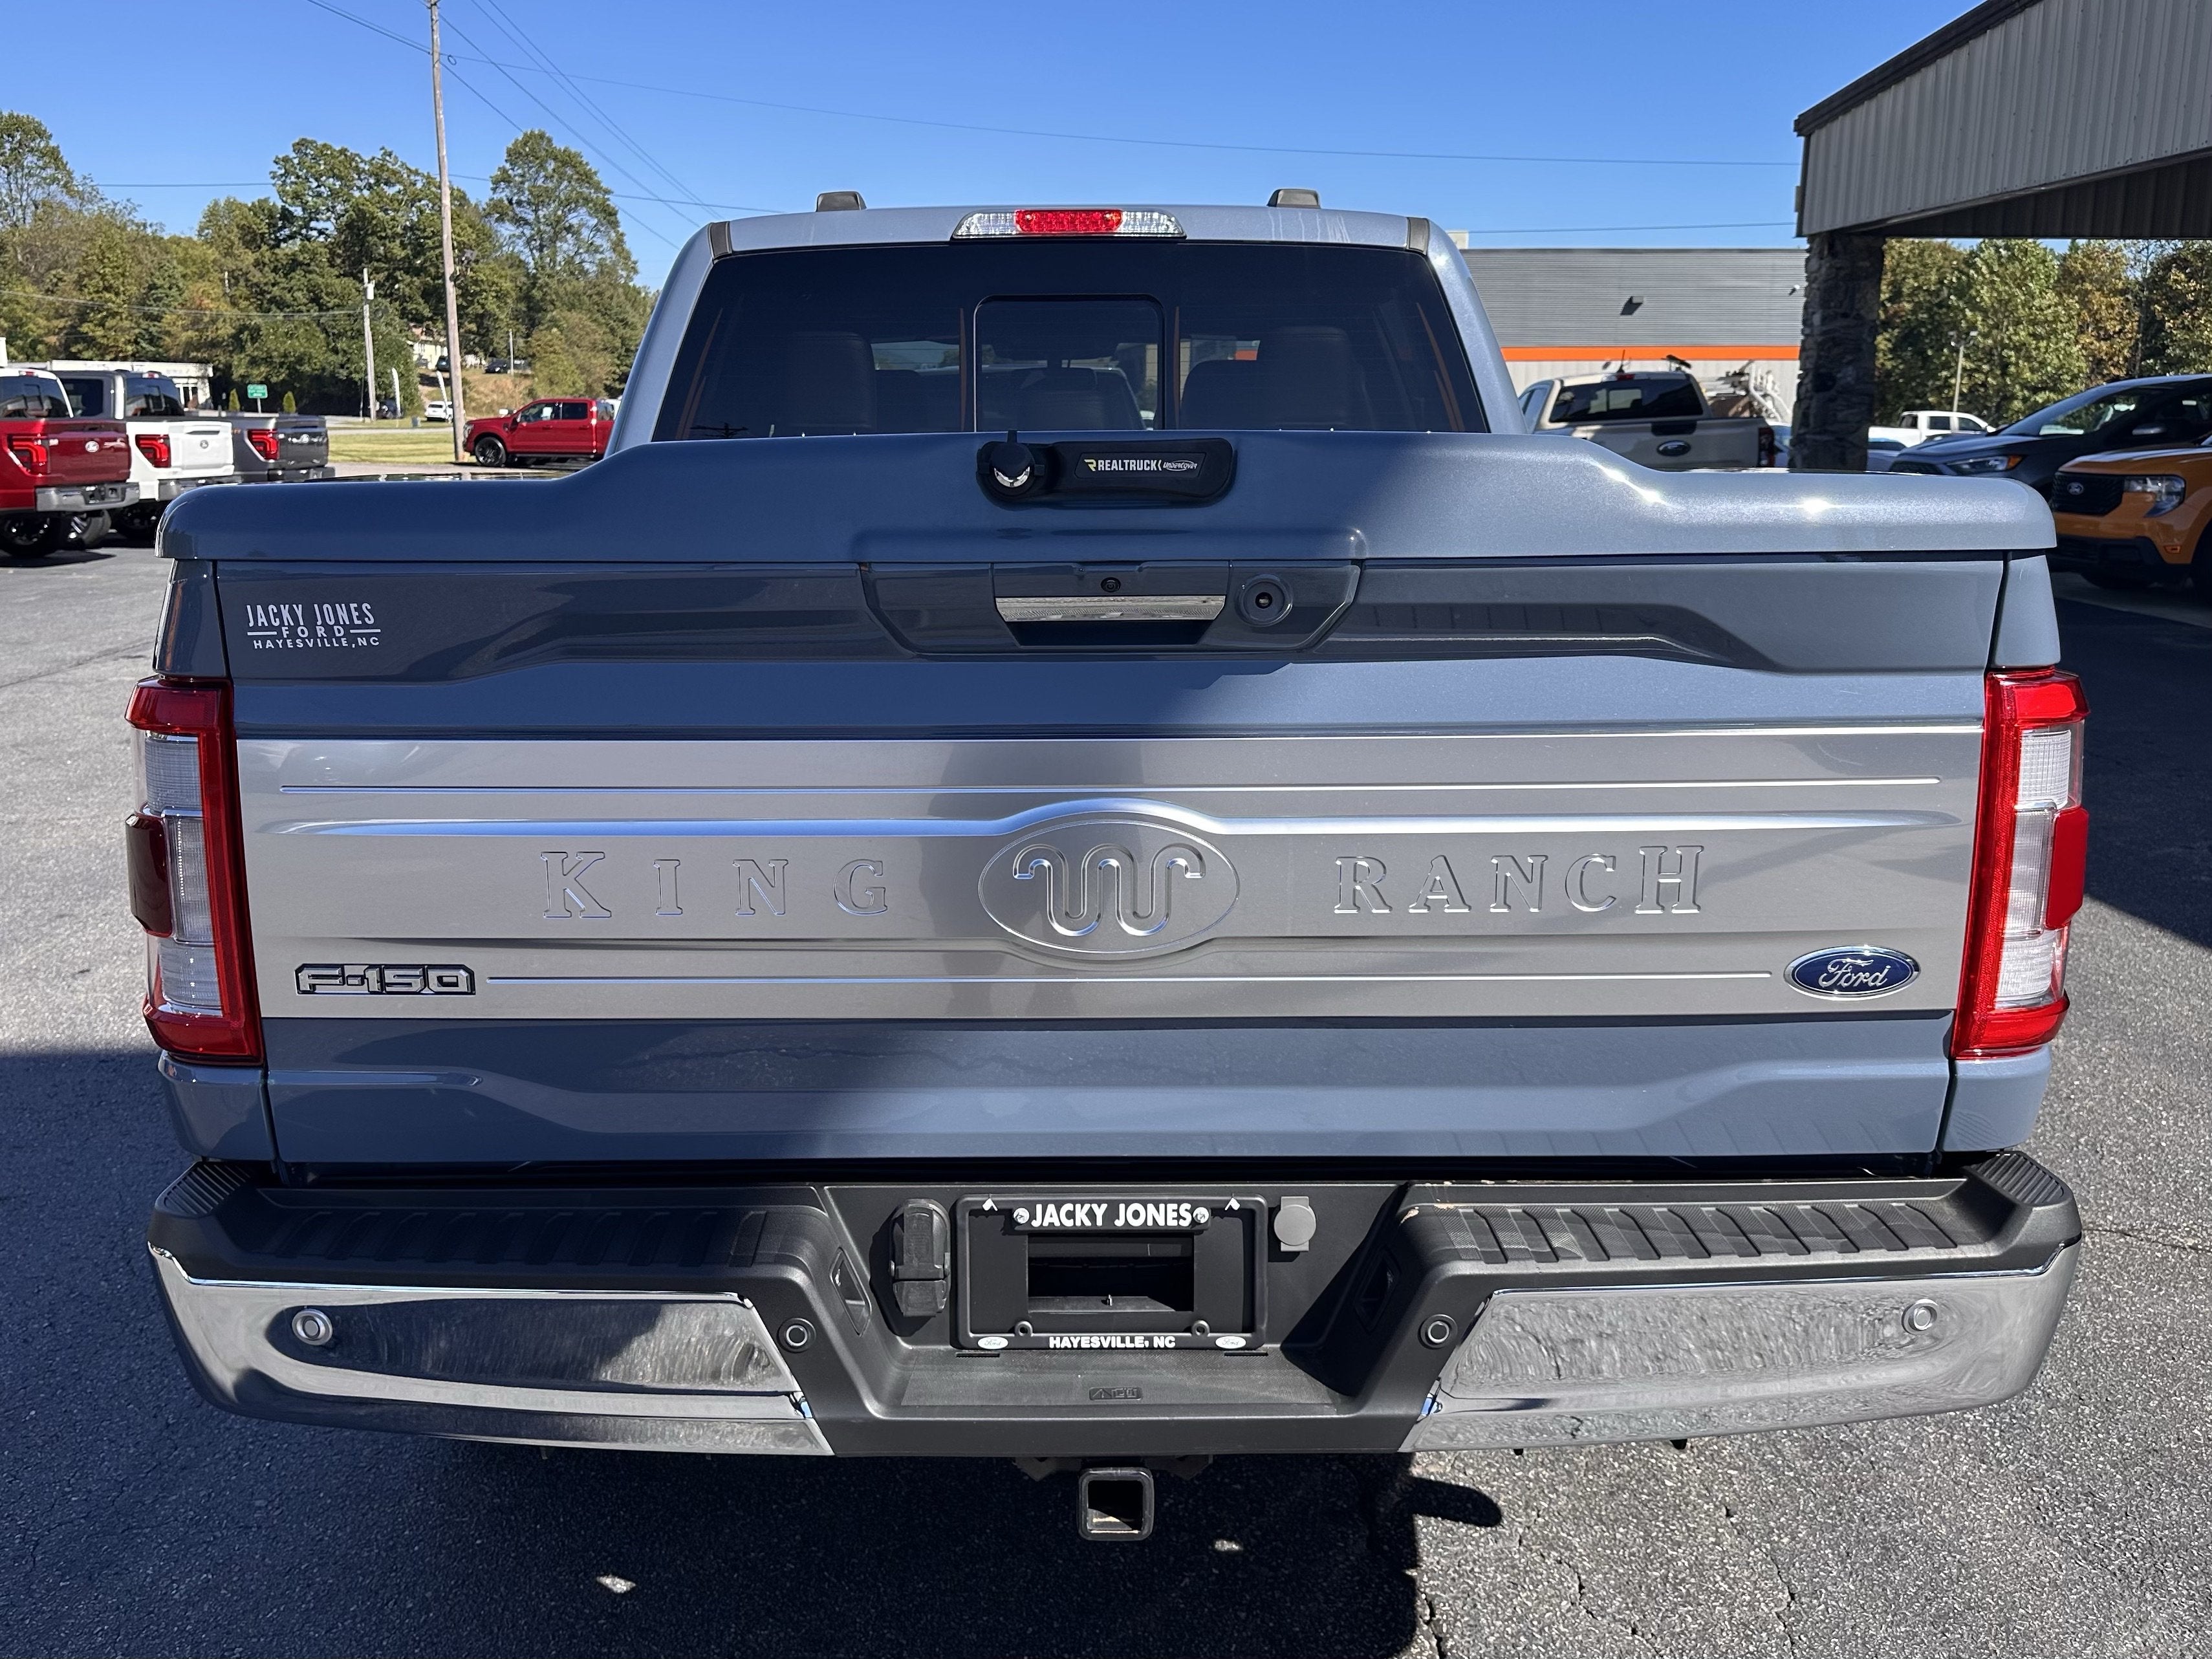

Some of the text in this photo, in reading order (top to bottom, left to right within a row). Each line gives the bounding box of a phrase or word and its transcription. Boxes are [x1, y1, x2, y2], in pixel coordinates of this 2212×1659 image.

[1098, 460, 1157, 471] REALTRUCK
[246, 603, 374, 627] JACKY JONES
[281, 625, 344, 638] FORD
[541, 845, 1704, 918] KING RANCH
[294, 963, 476, 995] F-150
[1818, 958, 1892, 988] Ford
[1031, 1202, 1192, 1228] JACKY JONES
[1049, 1336, 1176, 1349] HAYESVILLE, NC
